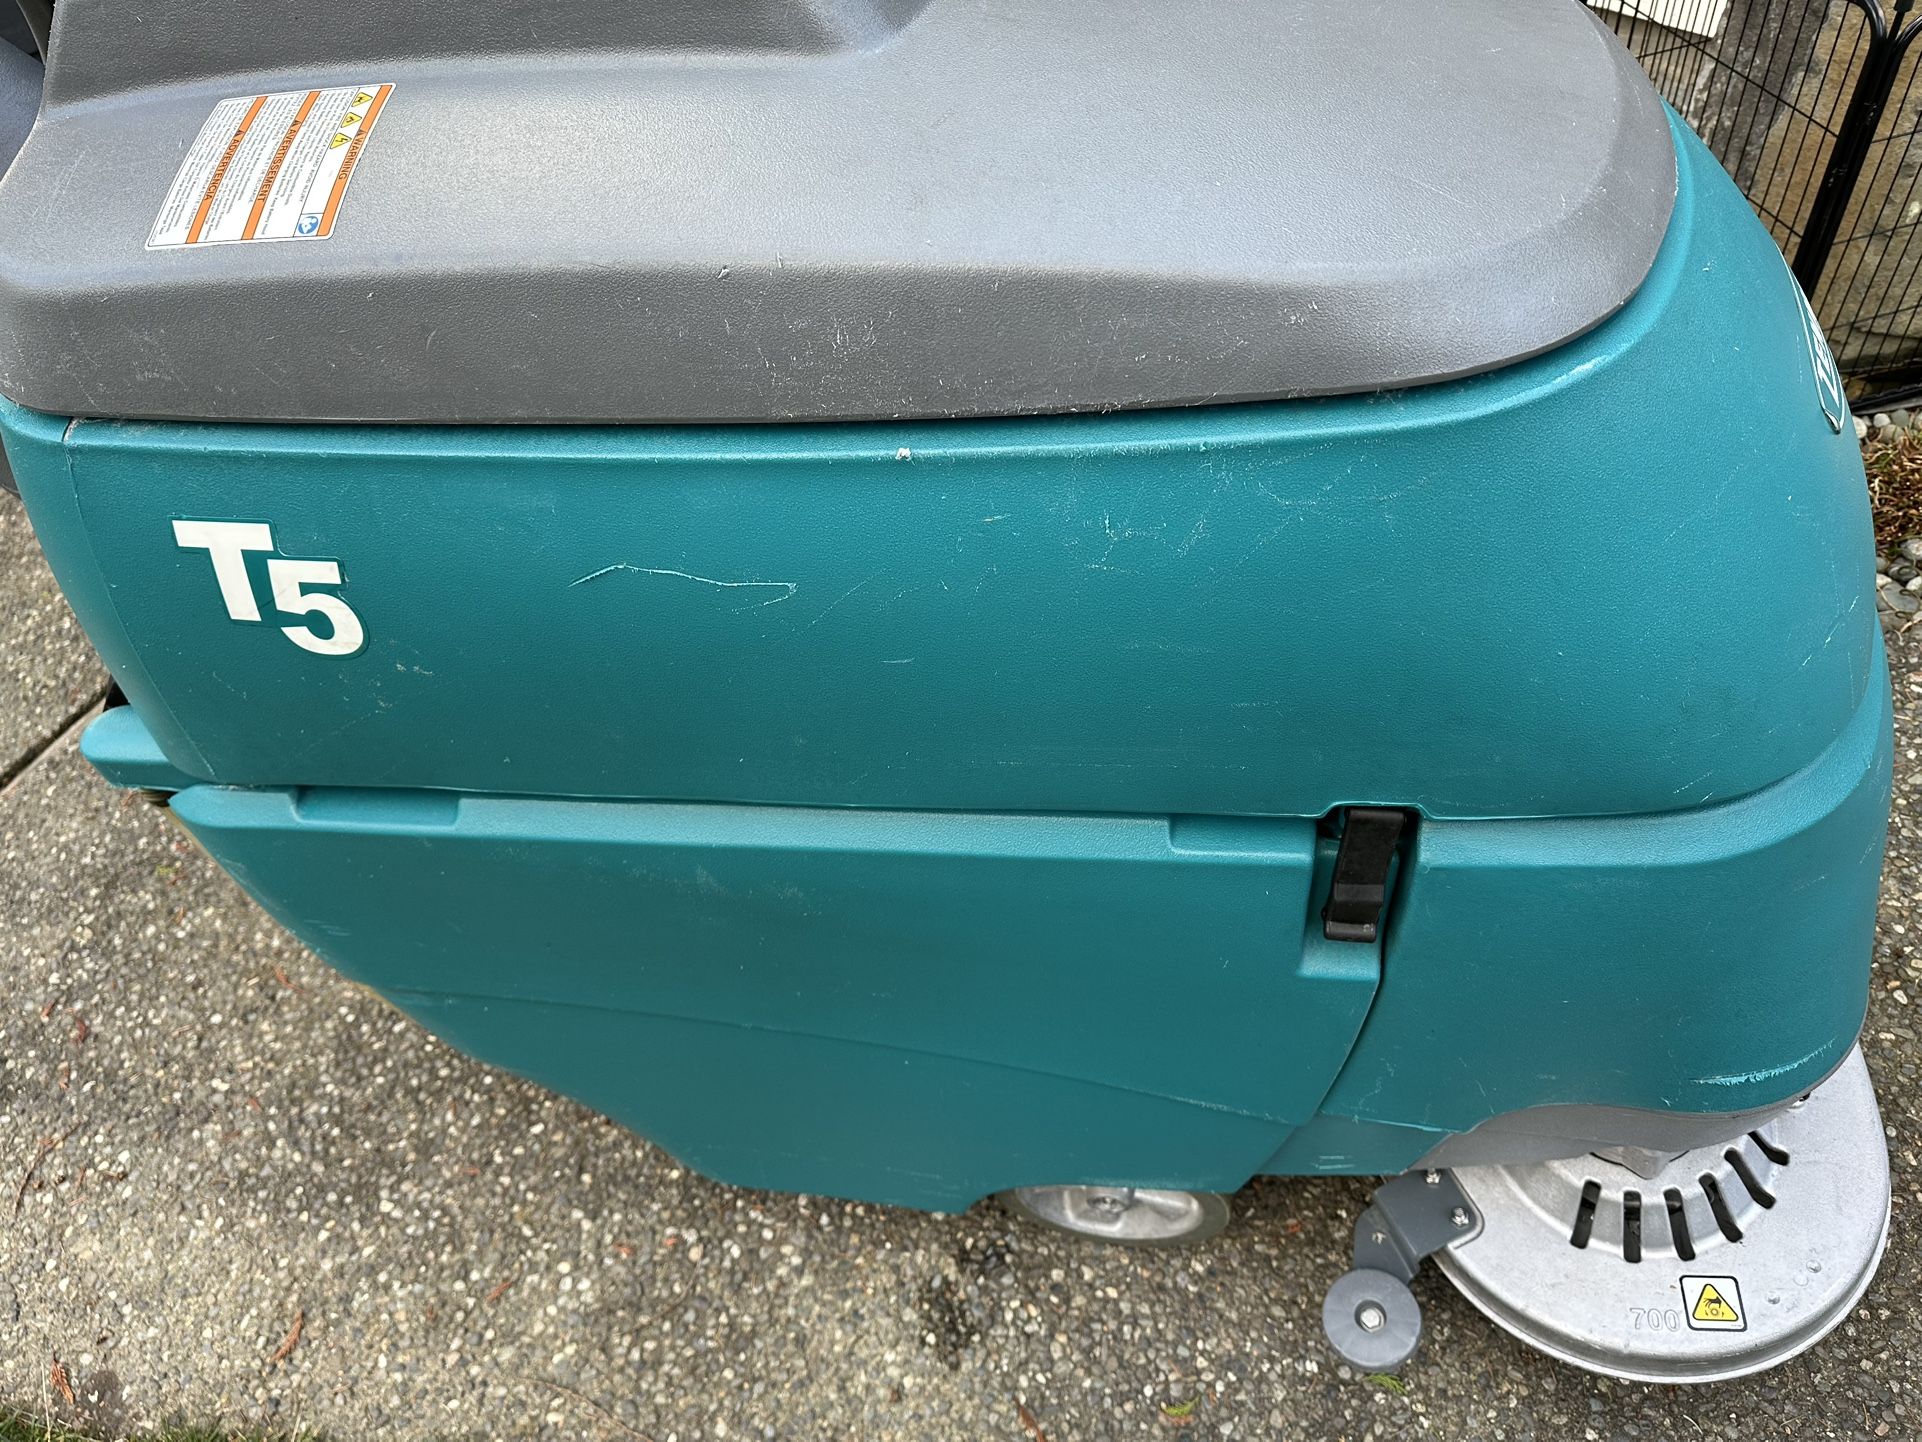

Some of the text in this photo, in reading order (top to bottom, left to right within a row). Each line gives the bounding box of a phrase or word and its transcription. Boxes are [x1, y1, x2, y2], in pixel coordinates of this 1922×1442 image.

[203, 138, 240, 202] ADVERTENCIA
[256, 127, 298, 203] AVERTISSEMENT
[337, 136, 362, 180] WARNING
[172, 520, 364, 656] T5
[1629, 1307, 1680, 1332] 700
